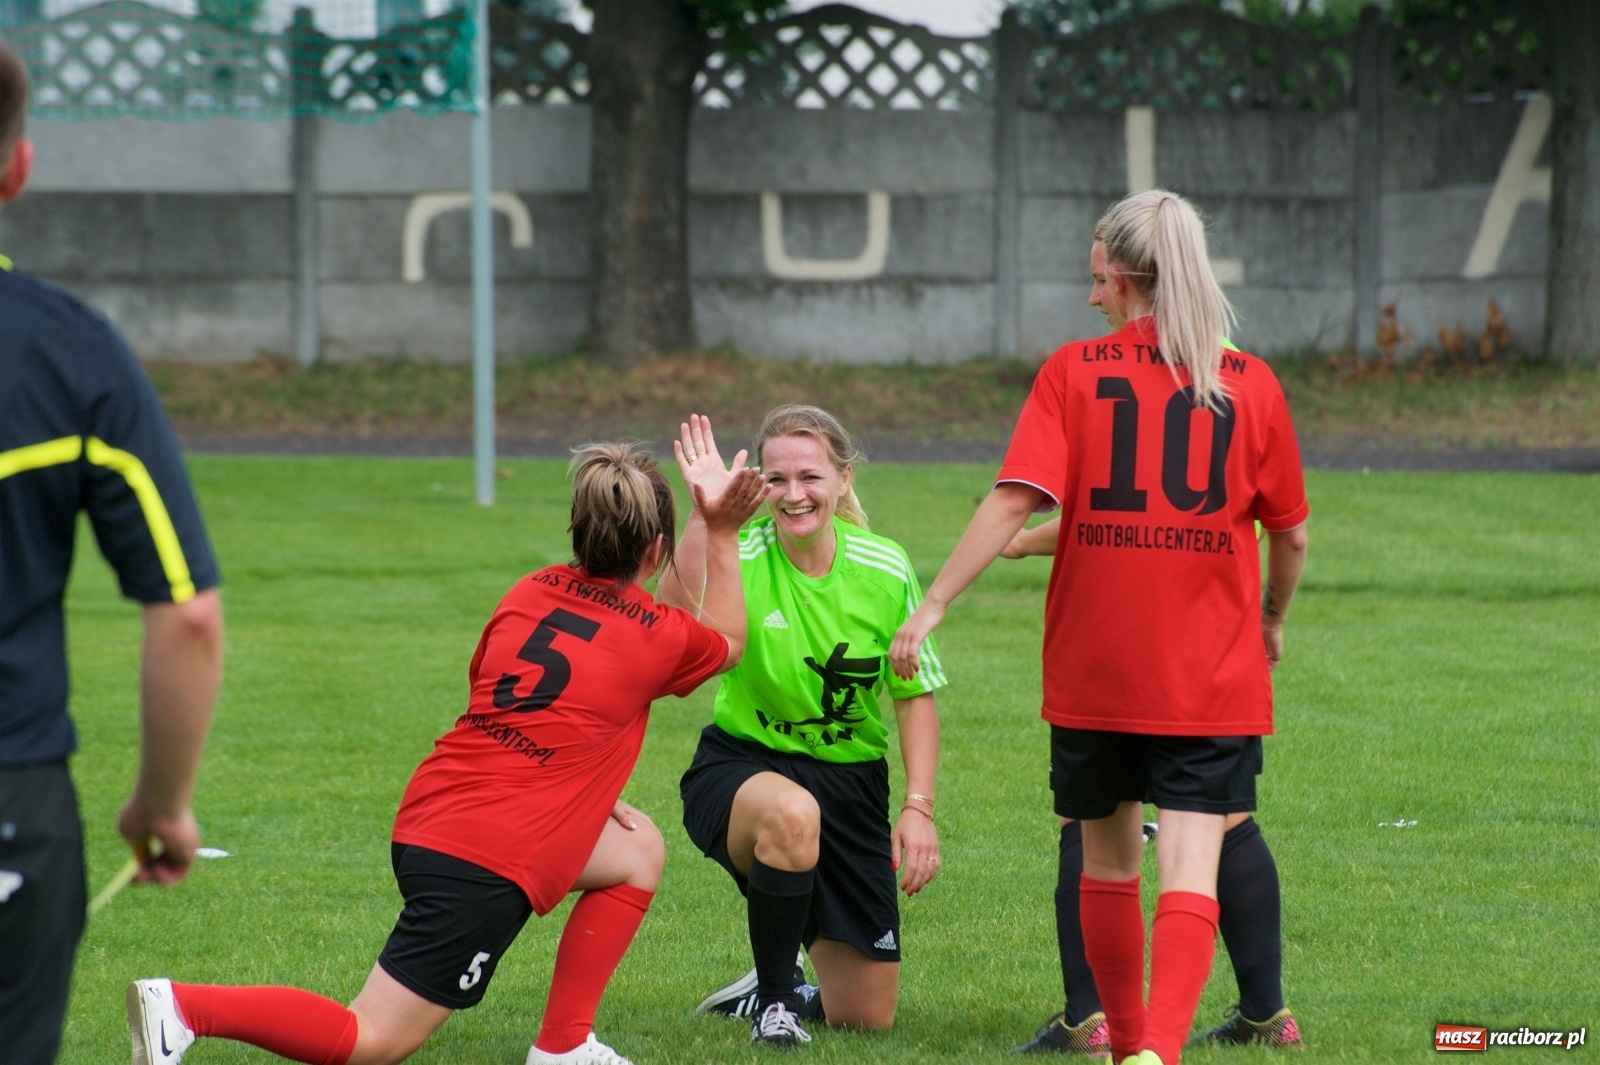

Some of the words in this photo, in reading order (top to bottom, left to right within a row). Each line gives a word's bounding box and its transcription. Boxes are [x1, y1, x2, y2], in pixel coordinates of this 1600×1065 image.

[1082, 343, 1123, 362] LKS
[1090, 376, 1235, 516] 10
[1077, 523, 1235, 555] FOOTBALLCENTER.PL
[492, 606, 602, 713] 5
[755, 708, 792, 736] Va
[459, 951, 491, 991] 5
